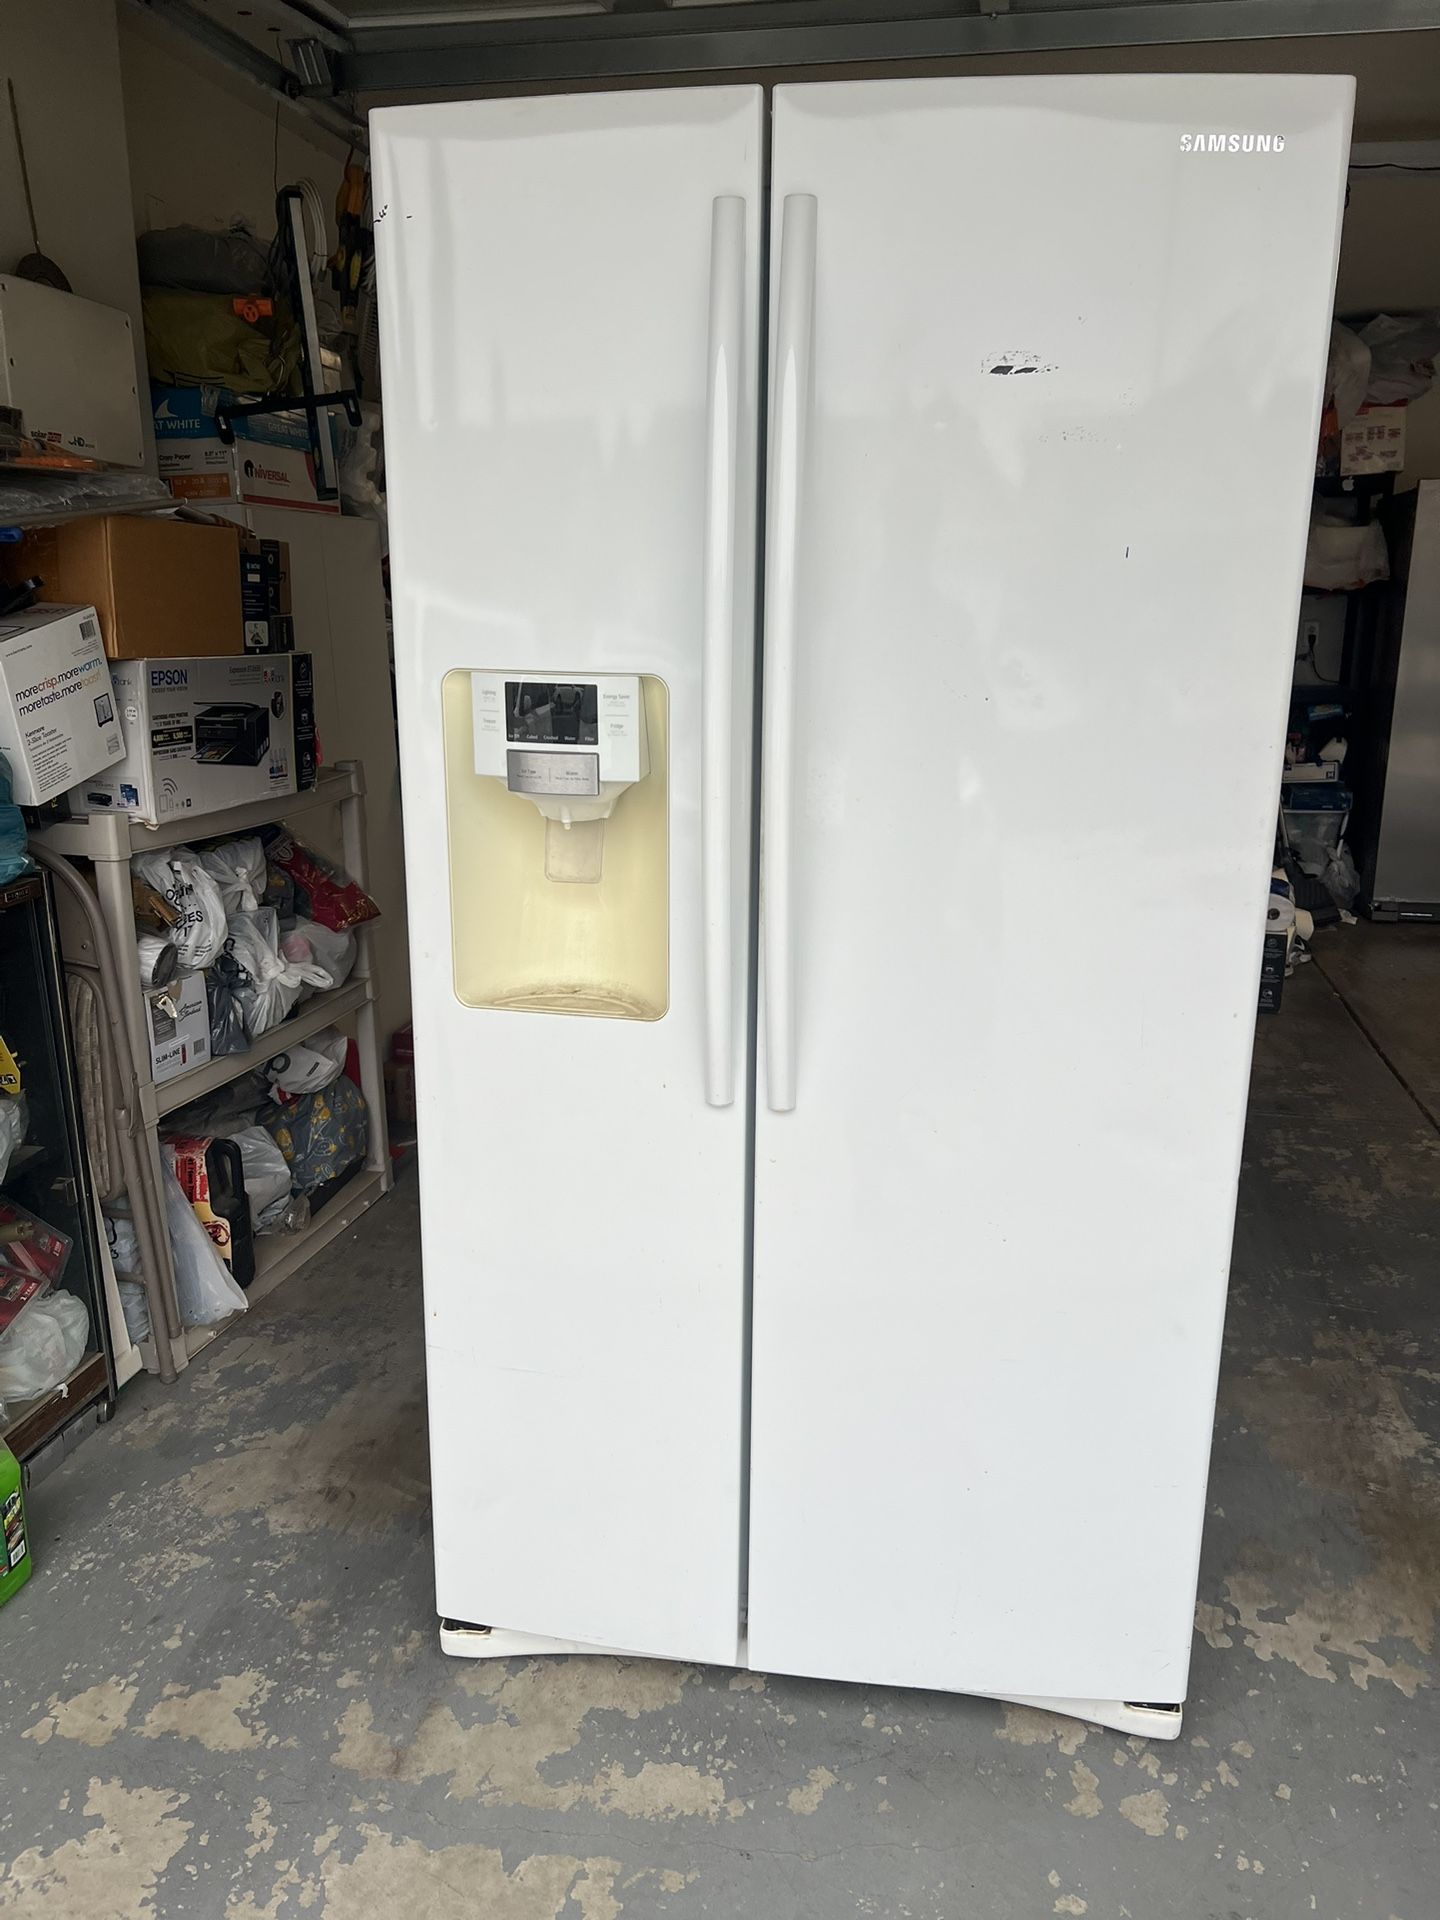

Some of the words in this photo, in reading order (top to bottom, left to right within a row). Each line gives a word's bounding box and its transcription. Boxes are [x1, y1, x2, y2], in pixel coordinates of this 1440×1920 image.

[1180, 133, 1285, 153] SAMSUNG
[166, 418, 201, 431] WHITE
[151, 669, 188, 687] EPSON
[25, 725, 45, 739] Kenmore
[155, 1047, 181, 1065] SLIM-LINE
